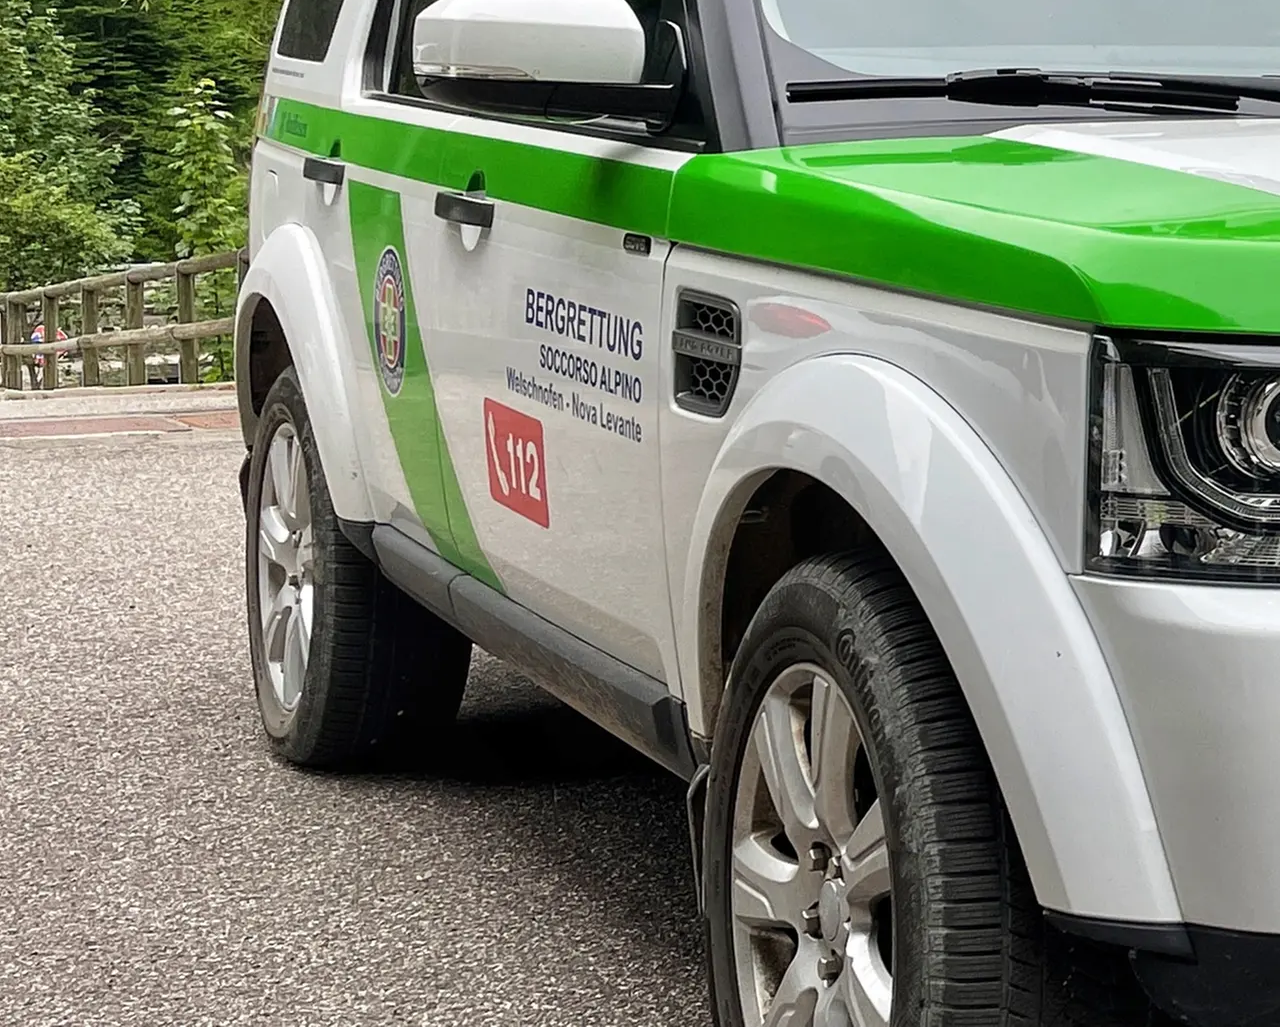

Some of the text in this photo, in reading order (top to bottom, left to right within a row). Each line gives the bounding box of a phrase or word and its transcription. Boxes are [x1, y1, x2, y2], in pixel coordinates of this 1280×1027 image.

[525, 287, 643, 361] BERGRETTUNG
[506, 366, 564, 412] Welschnofen
[572, 391, 598, 426] Nova
[600, 408, 643, 443] Levante
[539, 343, 642, 403] SOCCORSO ALPINO
[506, 432, 542, 502] 112
